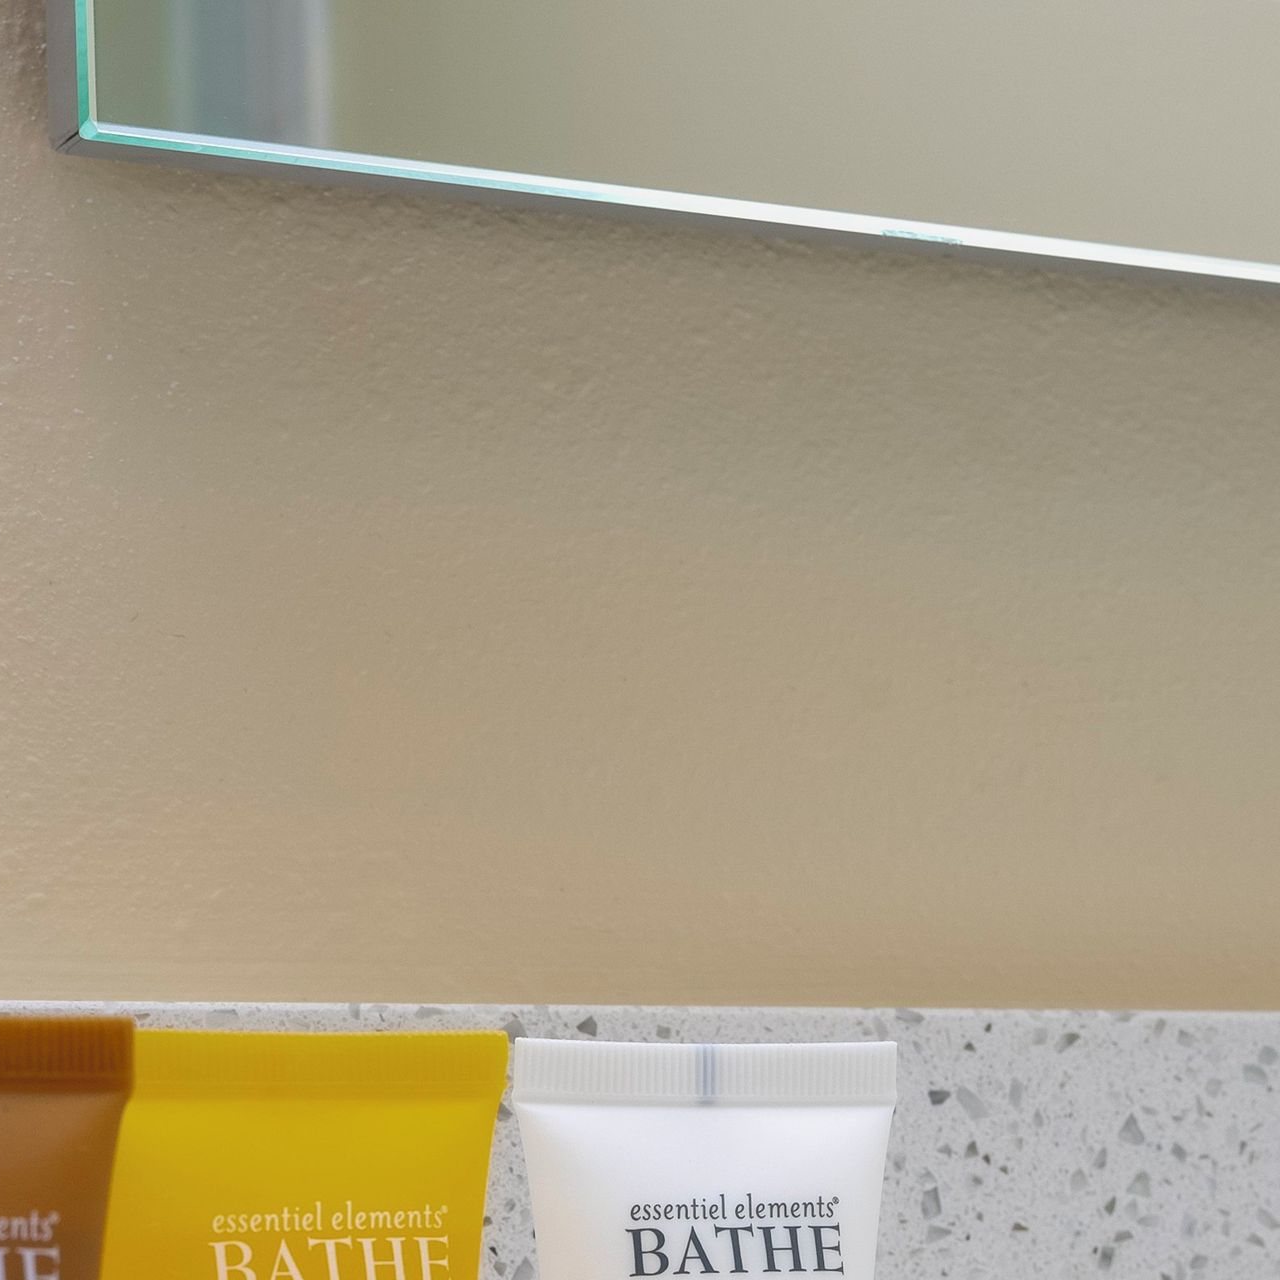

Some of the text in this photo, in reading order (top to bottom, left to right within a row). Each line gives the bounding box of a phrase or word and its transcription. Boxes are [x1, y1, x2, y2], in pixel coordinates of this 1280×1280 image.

[212, 1201, 322, 1233] essentiel
[630, 1193, 727, 1221] essentiel
[625, 1223, 844, 1277] BATHE
